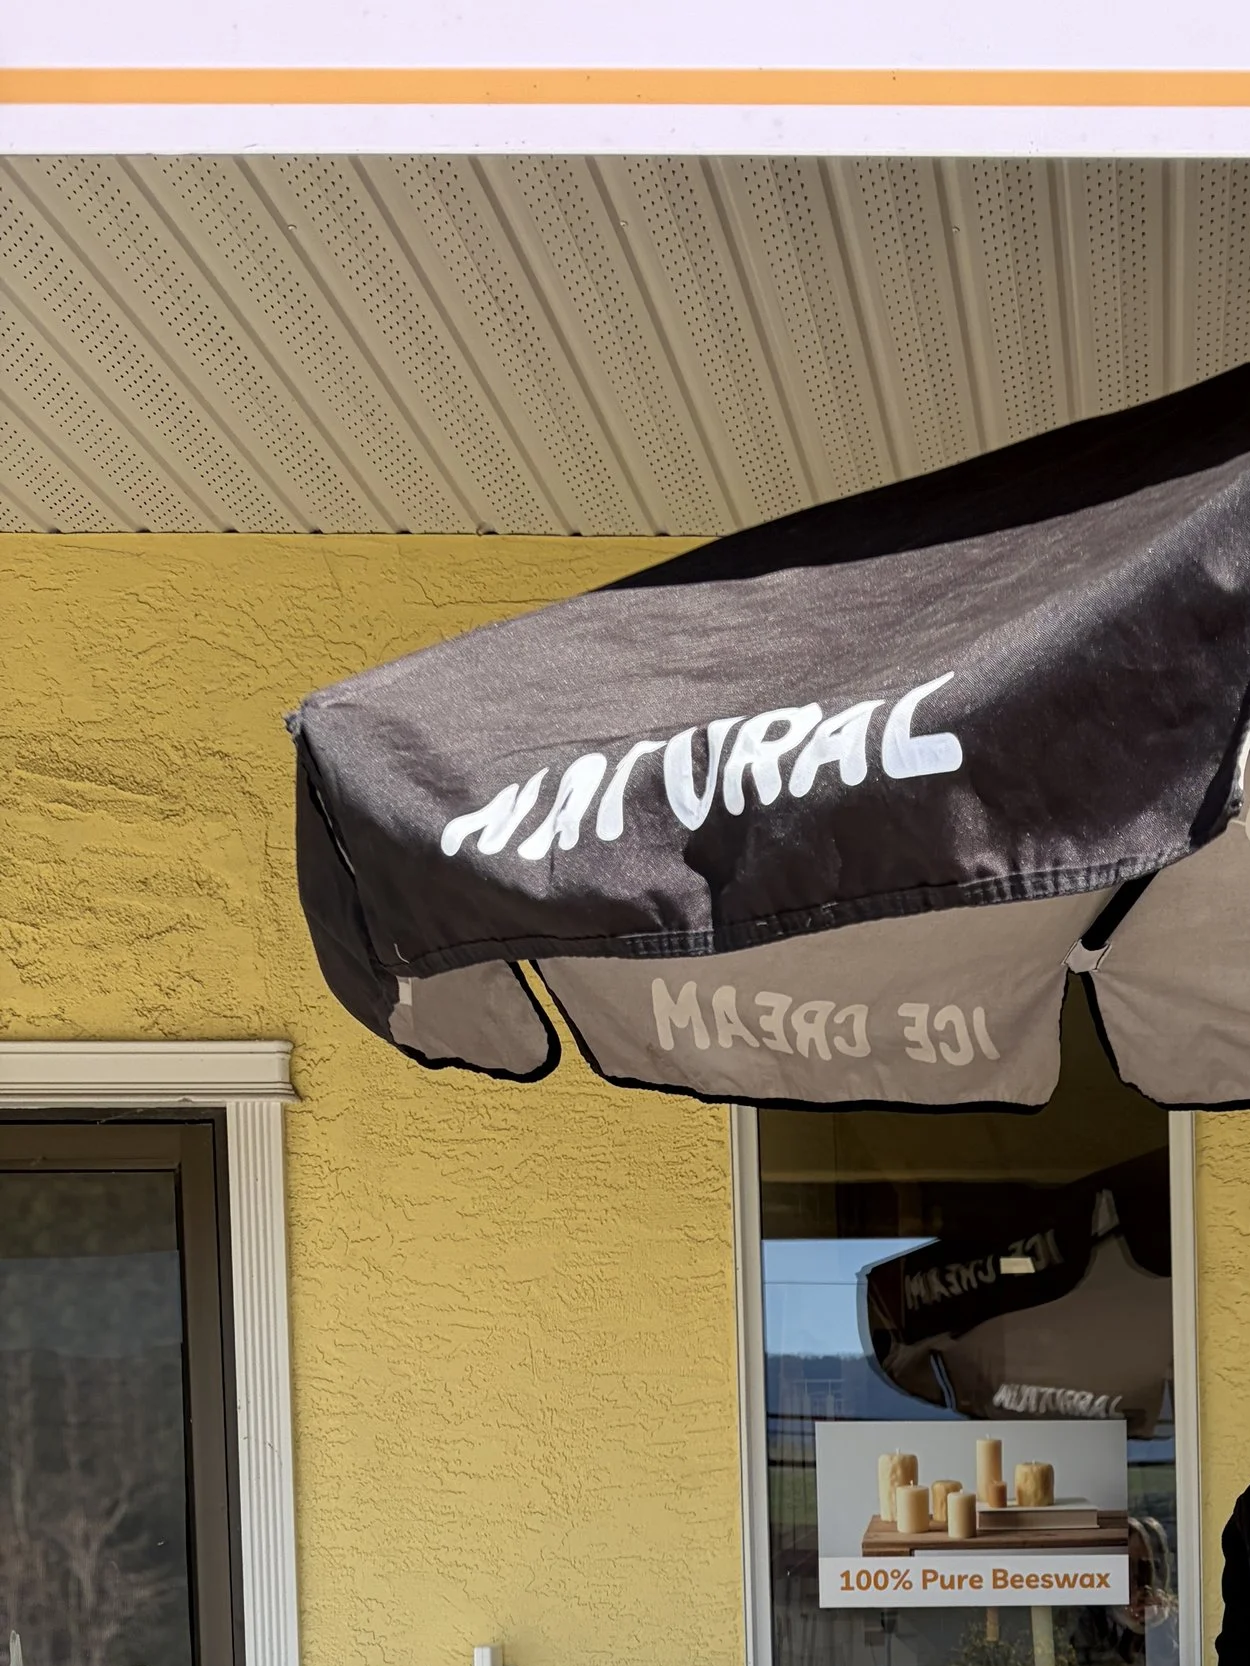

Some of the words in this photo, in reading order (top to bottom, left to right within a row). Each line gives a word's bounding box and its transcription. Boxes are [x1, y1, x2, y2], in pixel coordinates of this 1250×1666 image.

[441, 671, 963, 860] NATURAL
[840, 1568, 914, 1592] 100%
[921, 1568, 984, 1590] Pure
[992, 1568, 1112, 1590] Beeswax
